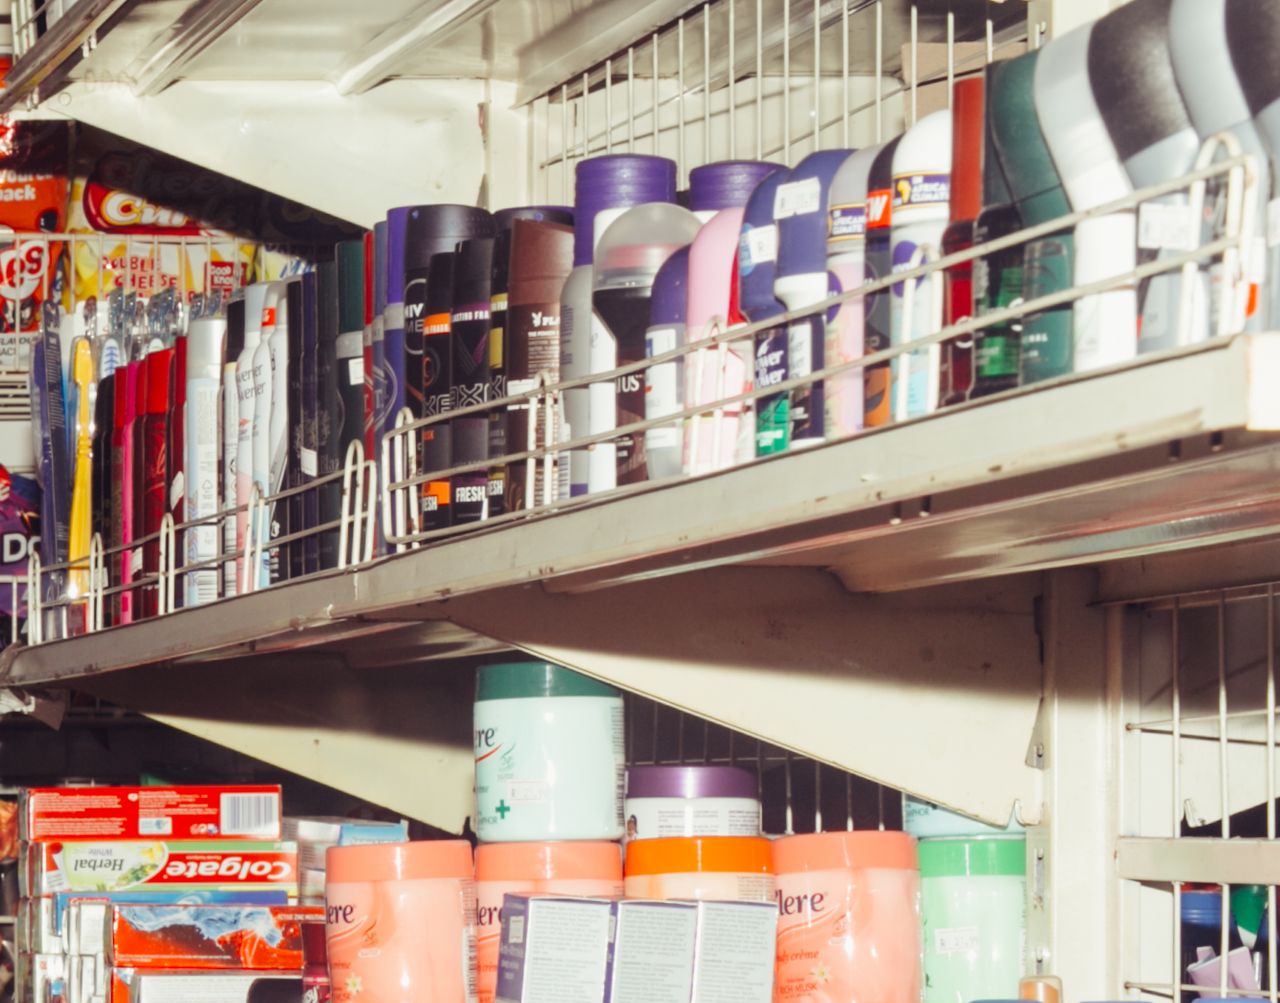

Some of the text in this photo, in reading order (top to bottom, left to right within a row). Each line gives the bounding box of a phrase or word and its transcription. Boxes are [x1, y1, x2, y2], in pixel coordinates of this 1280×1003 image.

[456, 485, 486, 503] FRESH
[74, 858, 124, 872] Herbal
[166, 858, 292, 880] Colgate
[775, 889, 825, 916] lere
